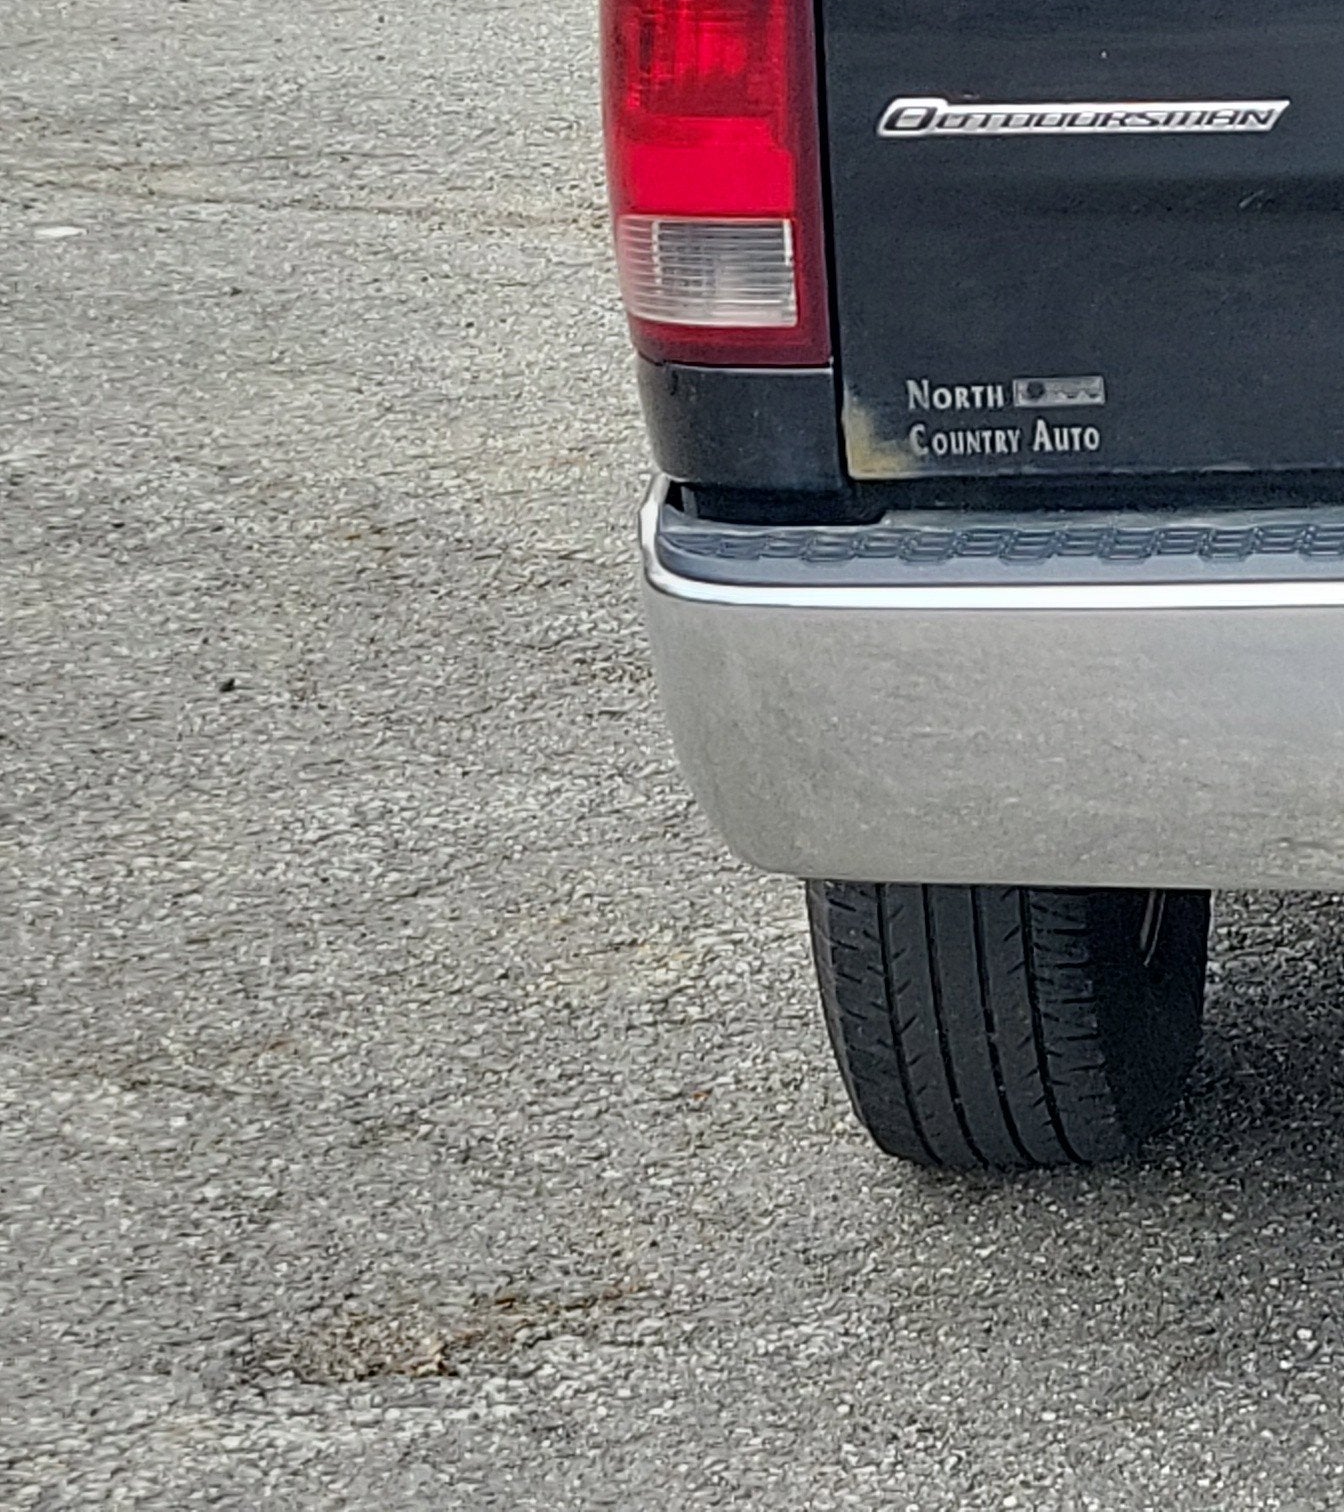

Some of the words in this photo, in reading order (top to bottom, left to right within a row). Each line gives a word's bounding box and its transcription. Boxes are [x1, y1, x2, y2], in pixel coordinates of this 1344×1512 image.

[906, 379, 1004, 410] NORTH
[909, 424, 1020, 456] COUNTRY
[1033, 419, 1099, 452] AUTO
